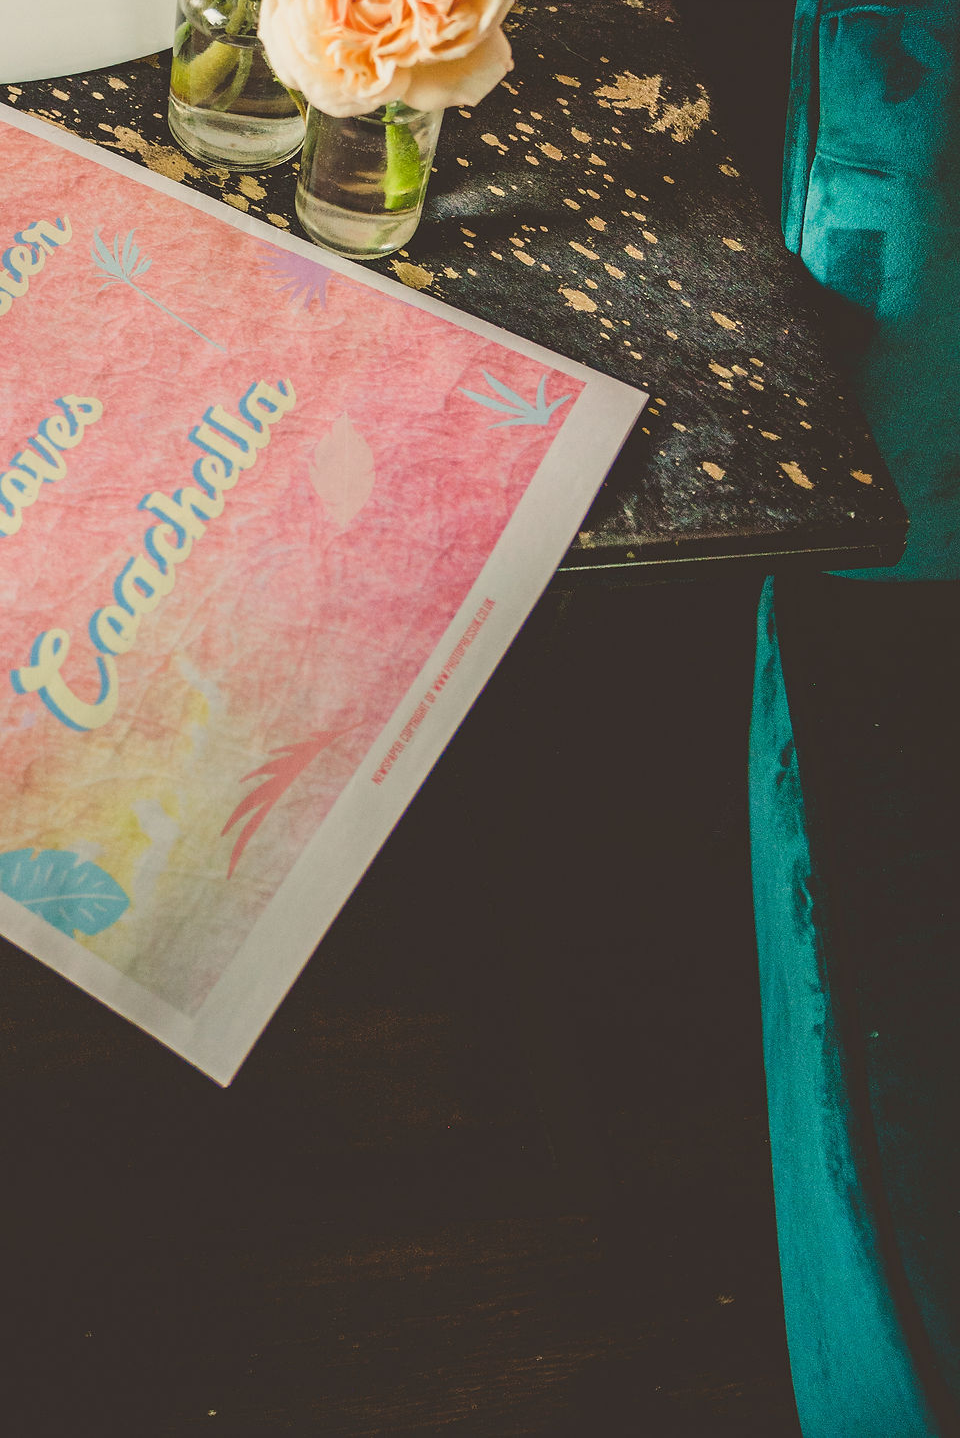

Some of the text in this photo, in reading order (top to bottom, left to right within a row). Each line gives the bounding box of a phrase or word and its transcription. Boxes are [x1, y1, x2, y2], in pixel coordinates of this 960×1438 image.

[10, 377, 297, 733] Coachella
[371, 740, 405, 786] NEWSPAPER
[399, 701, 431, 744] COPYRIGHT
[424, 691, 437, 704] OF
